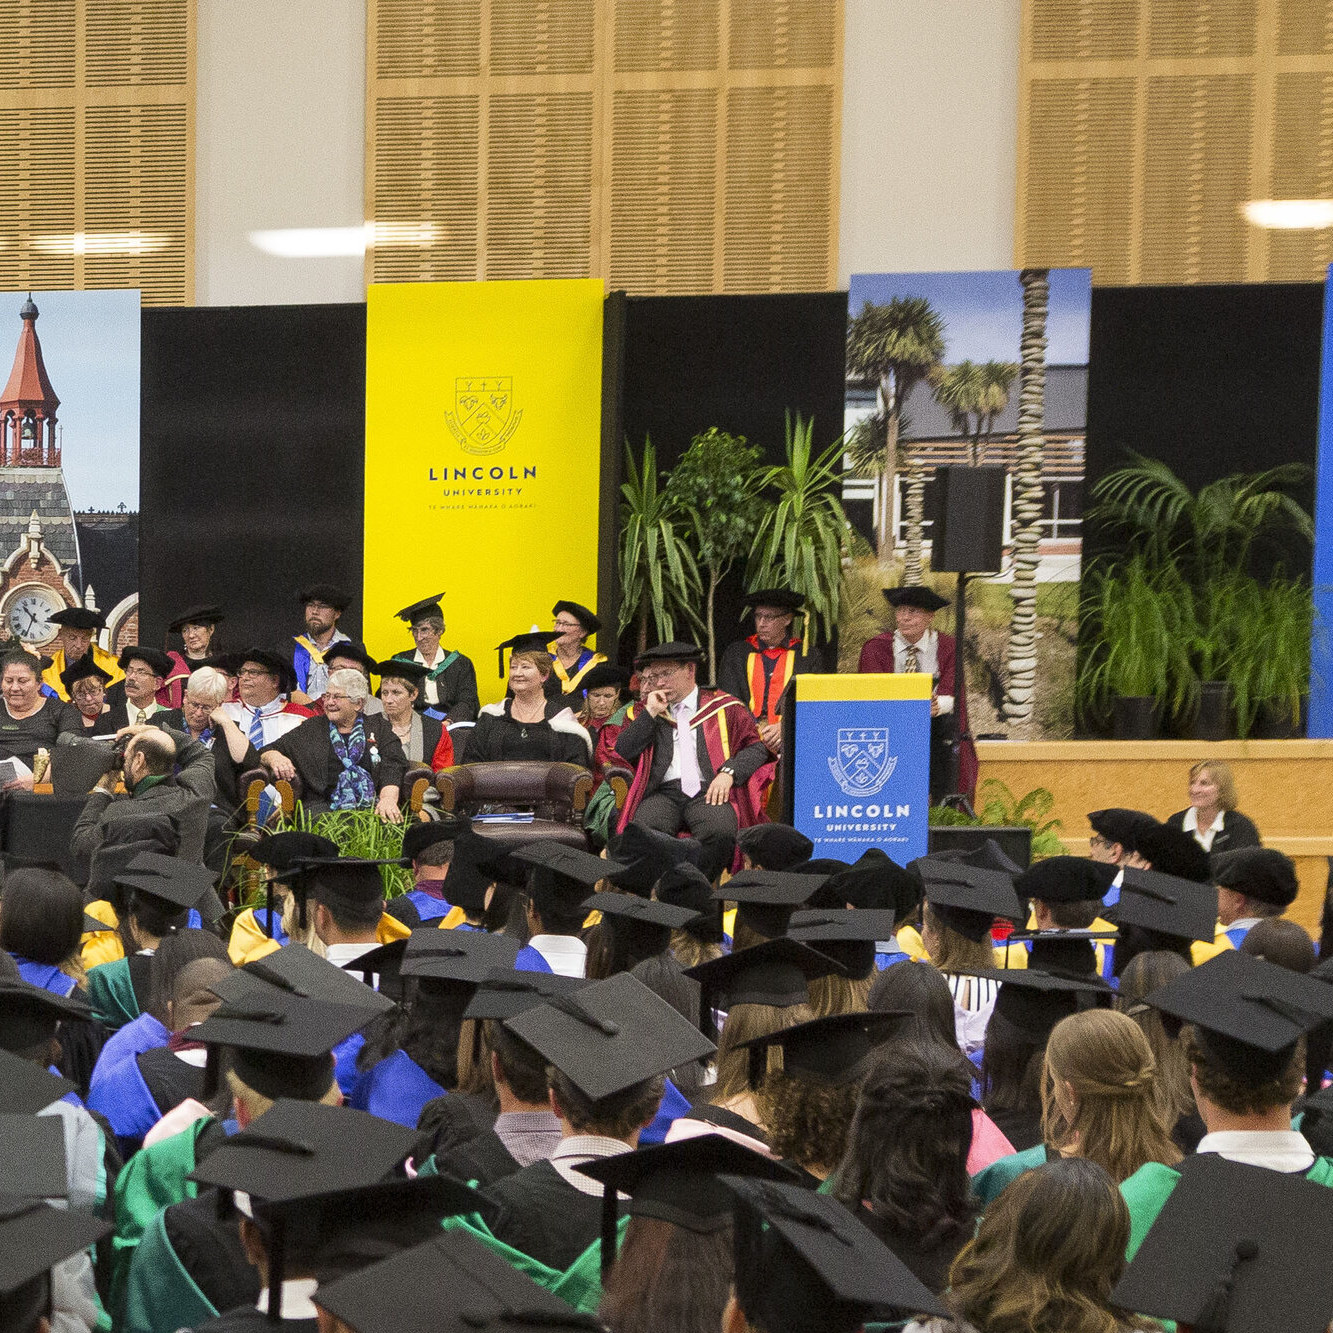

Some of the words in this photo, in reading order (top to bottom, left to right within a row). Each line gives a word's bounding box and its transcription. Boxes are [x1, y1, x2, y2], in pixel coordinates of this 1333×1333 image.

[429, 466, 536, 480] LINCOLN
[443, 488, 522, 496] UNIVERSITY
[814, 804, 910, 818] LINCOLN
[826, 824, 897, 832] UNIVERSITY
